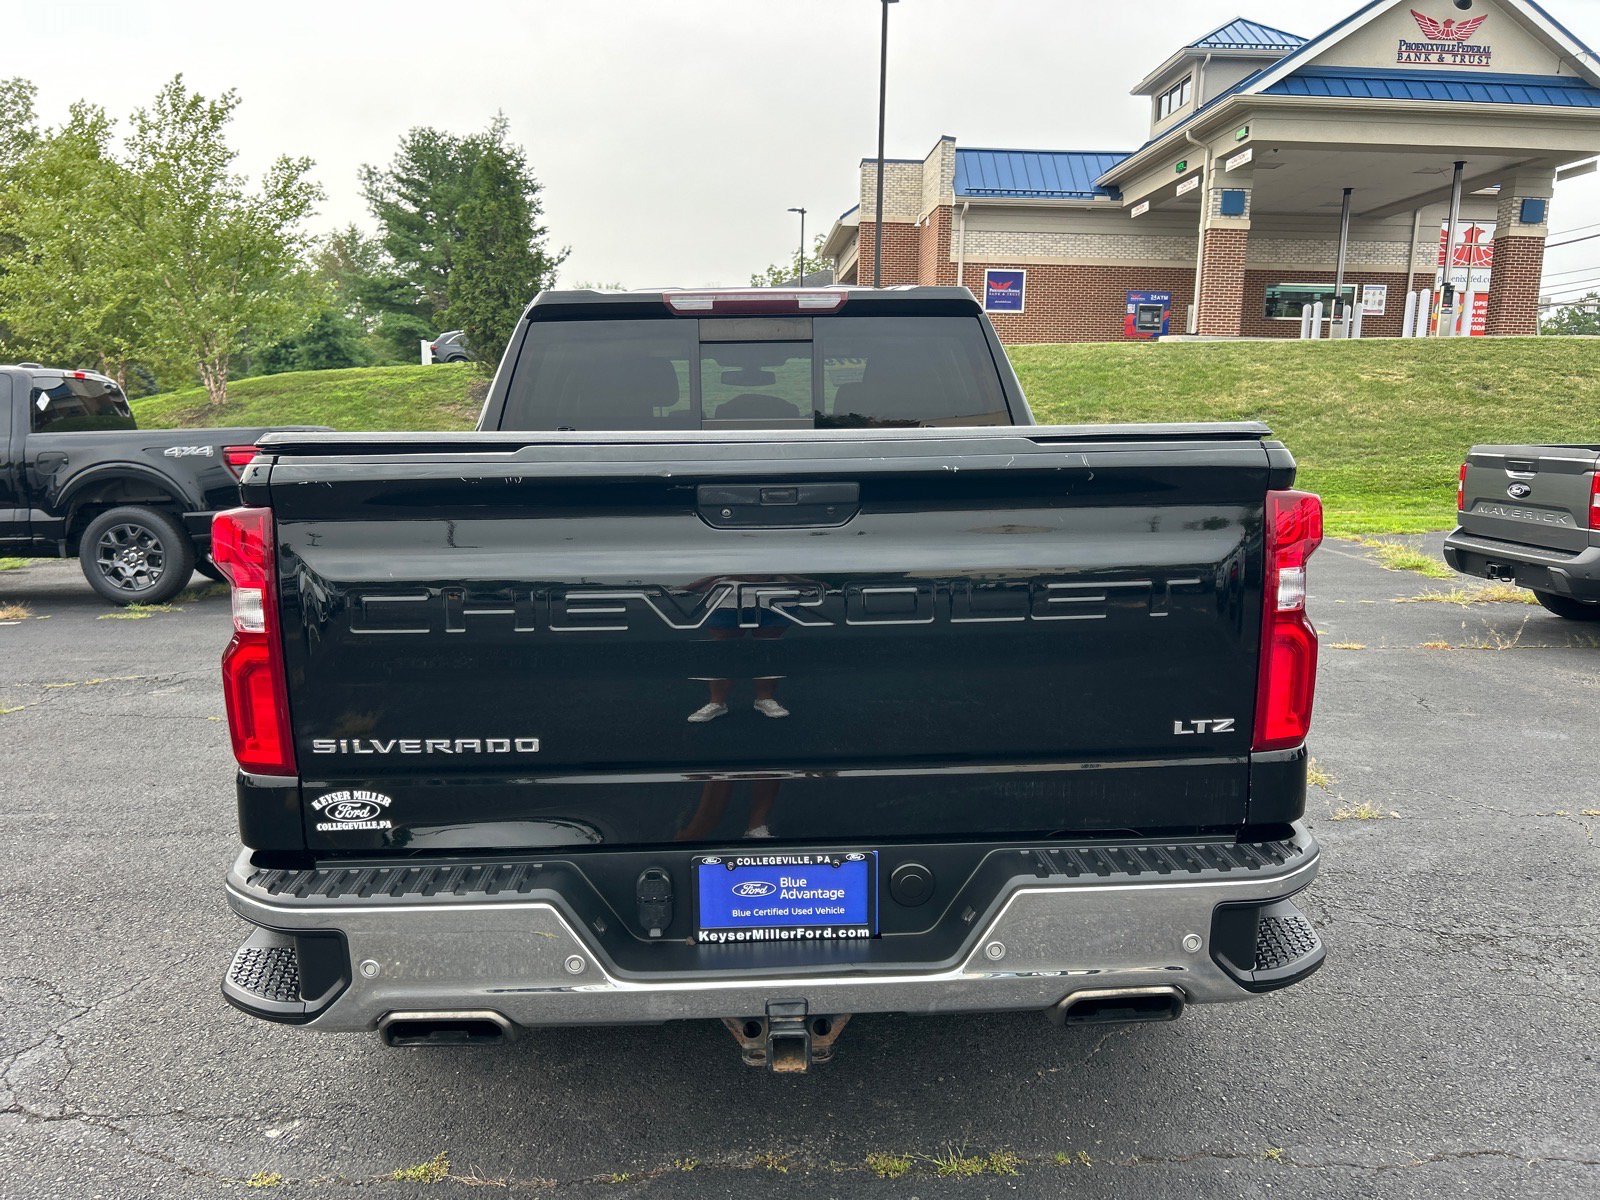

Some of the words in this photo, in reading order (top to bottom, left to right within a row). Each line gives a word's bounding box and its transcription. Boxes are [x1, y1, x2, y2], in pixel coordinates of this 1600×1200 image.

[1397, 53, 1431, 62] BANK
[1437, 54, 1446, 63] &
[1452, 55, 1491, 65] TRUST
[347, 579, 1201, 634] CHEVROLET
[1173, 718, 1235, 735] LTZ
[312, 738, 540, 754] SILVERADO
[311, 791, 351, 811] KEYSER
[352, 790, 392, 808] MILLER
[334, 801, 372, 820] Ford
[736, 856, 813, 866] COLLEGEVILLE,
[816, 855, 831, 864] PA
[740, 882, 768, 896] Ford
[780, 877, 808, 888] Blue
[779, 888, 846, 900] Advantage
[732, 909, 752, 917] Blue
[753, 907, 789, 917] Certified
[791, 907, 813, 915] Used
[815, 906, 846, 915] Vehicle
[698, 928, 870, 944] KeyserMillerFord.com
